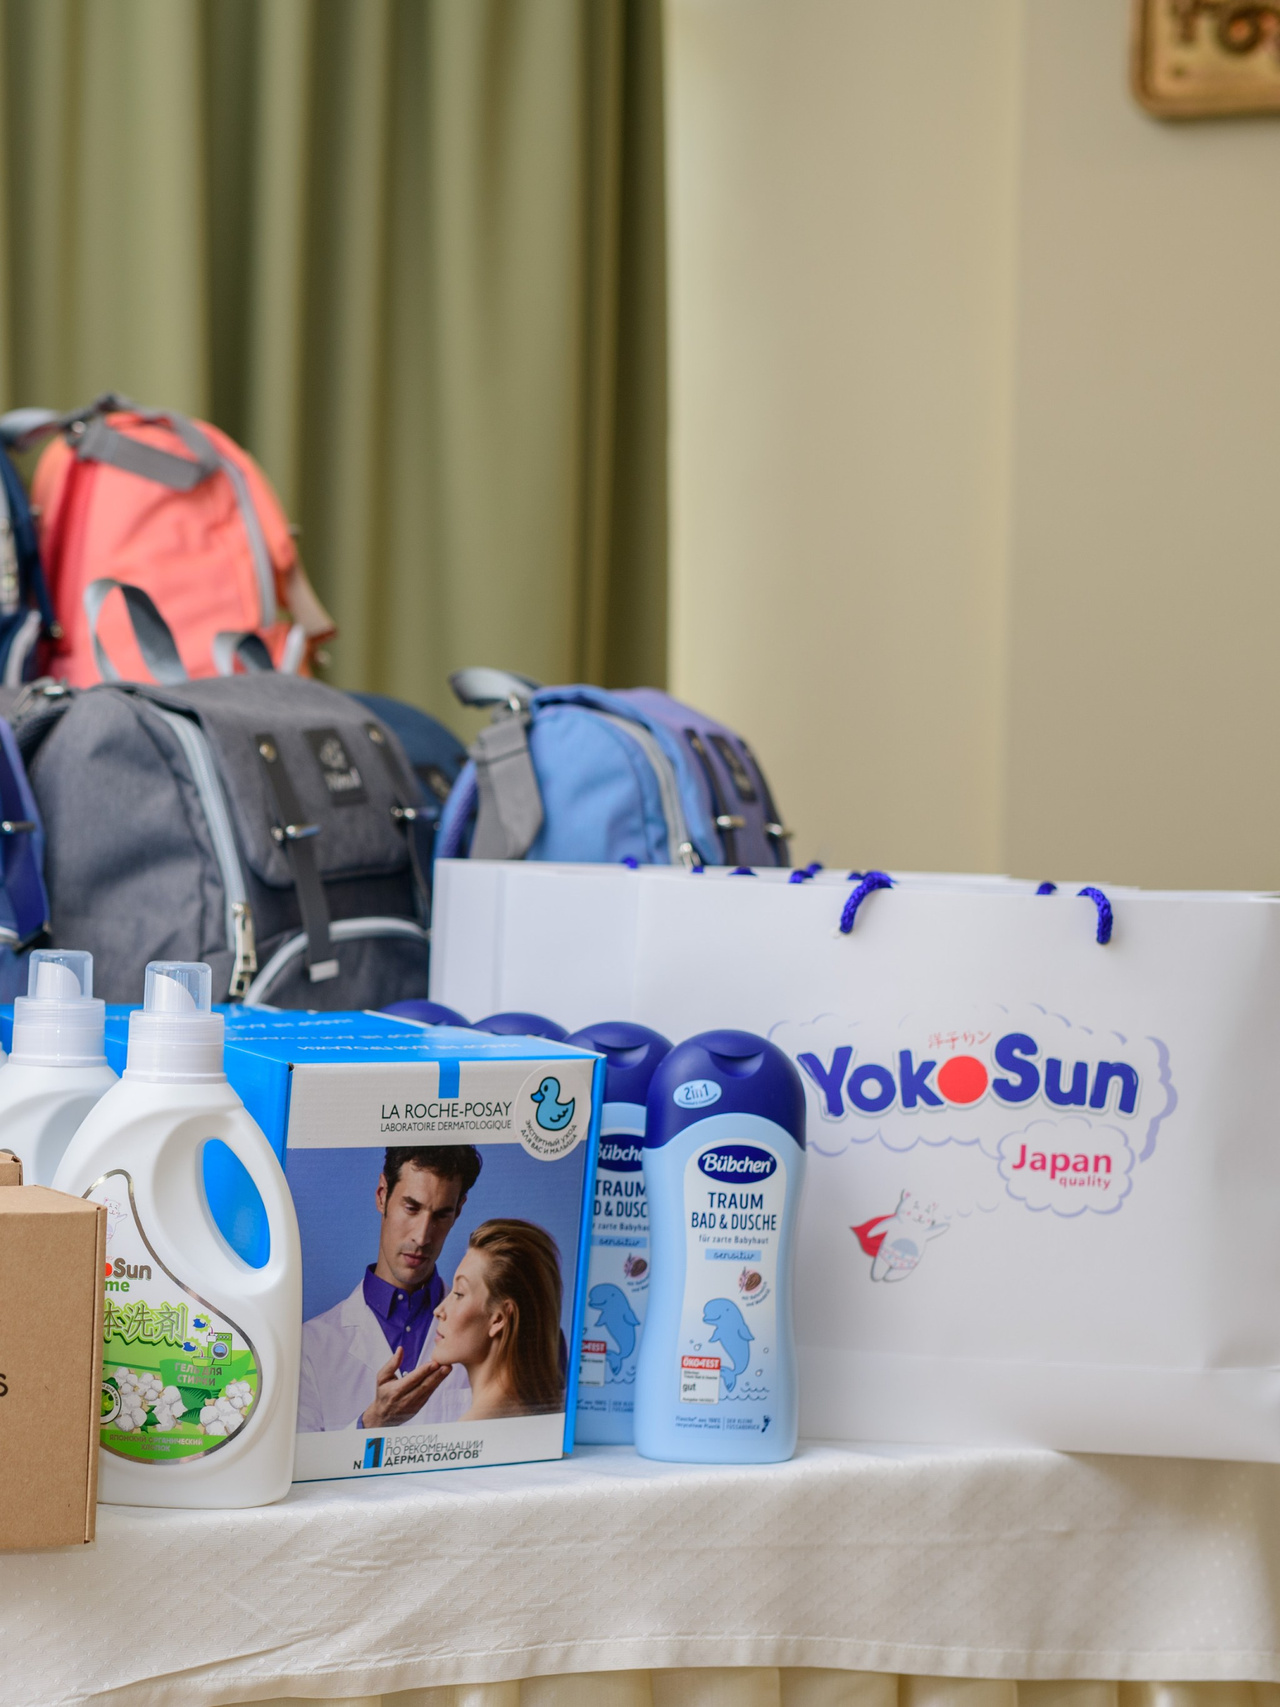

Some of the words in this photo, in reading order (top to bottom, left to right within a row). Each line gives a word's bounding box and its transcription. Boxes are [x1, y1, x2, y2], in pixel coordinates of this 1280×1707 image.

[683, 1083, 710, 1101] 2in1
[381, 1103, 400, 1119] LA
[404, 1101, 513, 1119] ROCHE-POSAY
[380, 1121, 436, 1133] LABORATOIRE
[437, 1119, 512, 1131] DERMATOLOGIQUE
[702, 1153, 771, 1174] Bübchen
[1012, 1144, 1112, 1180] Japan
[1059, 1174, 1111, 1190] quality
[707, 1191, 764, 1210] TRAUM
[616, 1201, 648, 1218] DUSC
[619, 1223, 650, 1233] Babyha
[691, 1211, 717, 1229] BAD
[719, 1212, 728, 1230] &
[731, 1213, 777, 1231] DUSCHE
[698, 1234, 711, 1243] für
[712, 1235, 732, 1244] zarte
[733, 1235, 769, 1246] Babyhaut
[104, 1280, 130, 1292] me
[174, 1361, 200, 1375] ГЕЛЬ
[201, 1366, 223, 1376] ДЛЯ
[177, 1374, 216, 1386] СТИРКИ
[682, 1383, 696, 1392] gut
[109, 1434, 147, 1443] ЯПОНСКИЙ
[385, 1437, 392, 1446] В
[395, 1434, 438, 1446] РОССИИ
[384, 1446, 402, 1457] ПО
[403, 1440, 484, 1455] РЕКОМЕНДАЦИИ
[384, 1449, 479, 1467] ДЕРМАТОЛОГОВ
